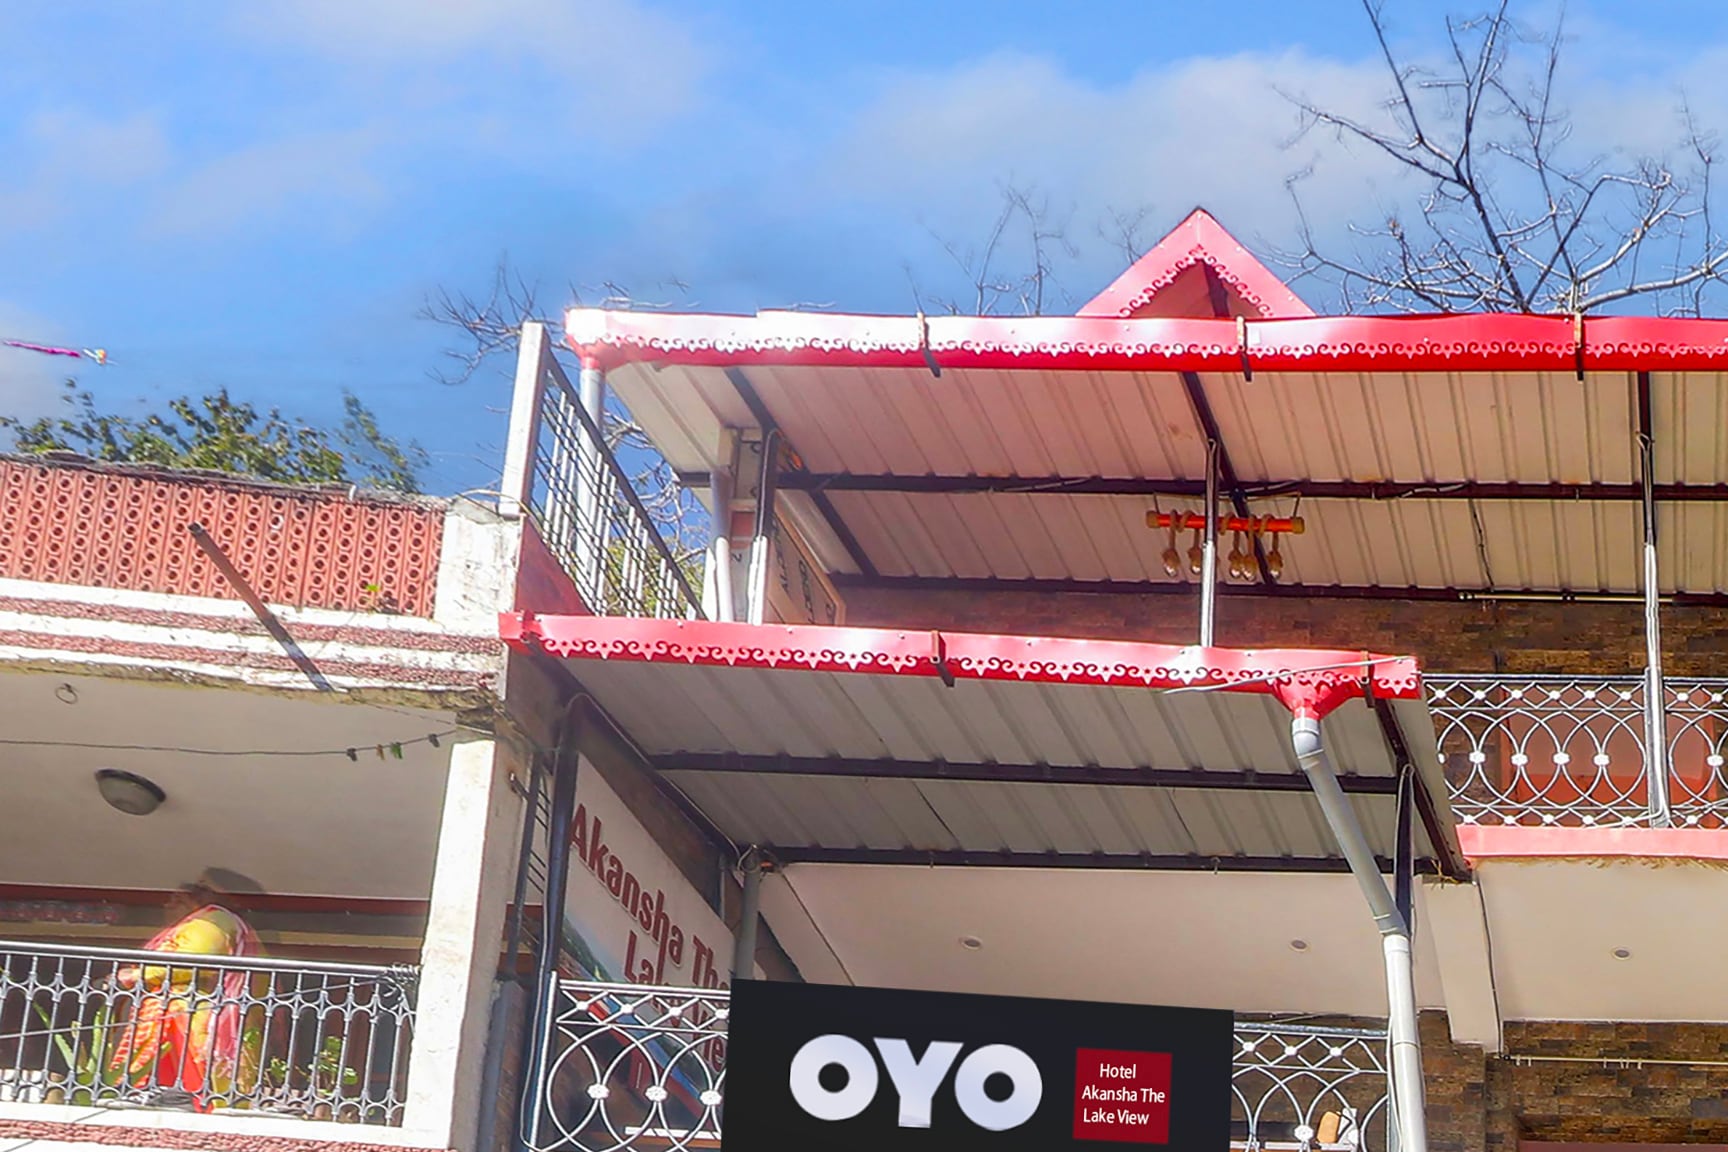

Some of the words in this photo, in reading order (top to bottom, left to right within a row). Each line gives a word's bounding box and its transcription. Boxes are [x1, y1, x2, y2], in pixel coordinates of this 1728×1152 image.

[566, 803, 685, 968] Akansha
[1099, 1063, 1137, 1079] Hotel
[788, 1033, 1043, 1131] OYO
[1081, 1084, 1138, 1102] Akansha
[1140, 1087, 1166, 1103] The
[1083, 1107, 1116, 1124] Lake
[1117, 1108, 1150, 1125] View
